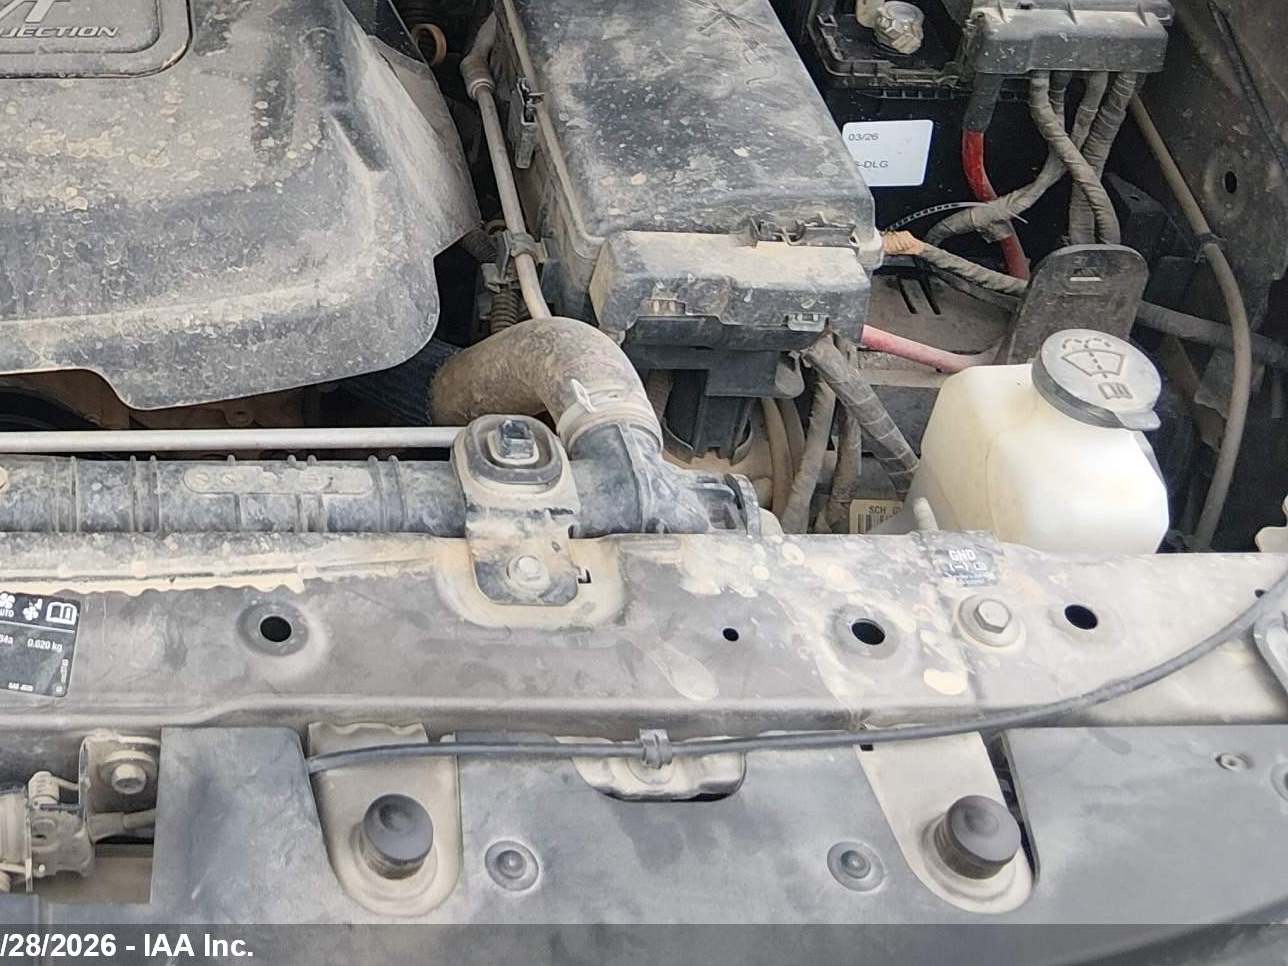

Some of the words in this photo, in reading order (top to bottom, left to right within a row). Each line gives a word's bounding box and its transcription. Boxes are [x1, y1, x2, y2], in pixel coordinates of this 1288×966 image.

[868, 505, 887, 515] SCH
[948, 548, 977, 562] GND
[51, 641, 63, 653] kg
